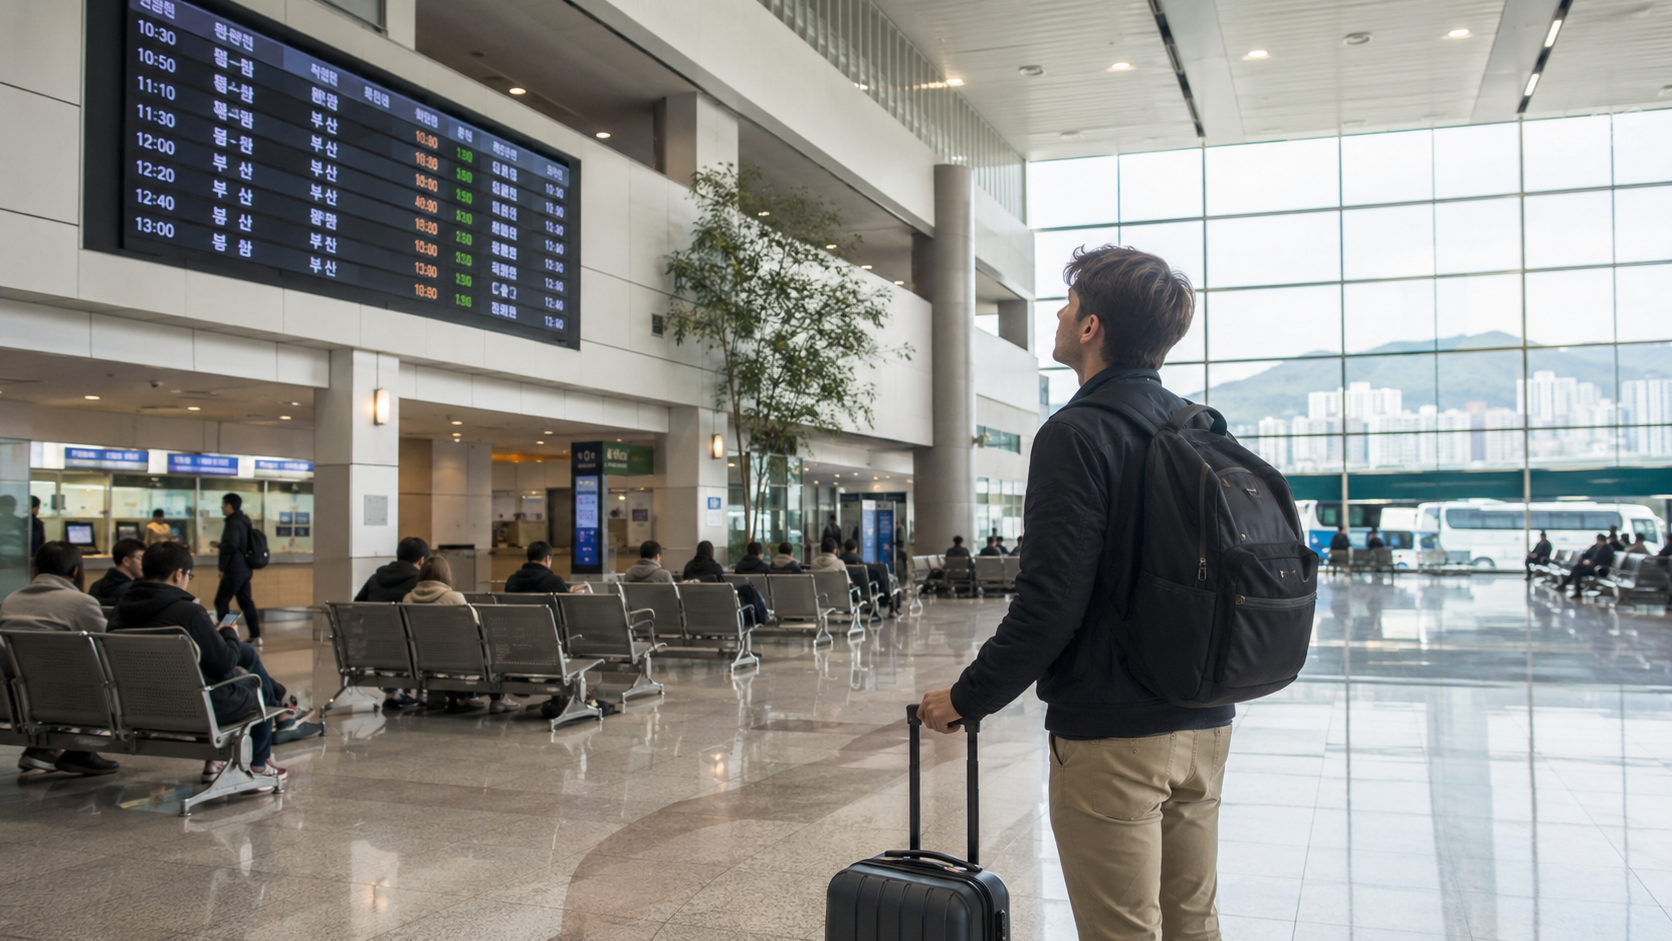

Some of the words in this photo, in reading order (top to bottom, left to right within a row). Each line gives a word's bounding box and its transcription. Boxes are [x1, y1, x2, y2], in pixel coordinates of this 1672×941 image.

[138, 19, 176, 45] 10:30
[138, 48, 176, 72] 10:50
[311, 110, 338, 134] 부산
[138, 76, 175, 100] 11:10
[311, 135, 338, 158] 부산
[137, 104, 175, 128] 11:30
[311, 160, 337, 182] 부산
[137, 132, 175, 155] 12:00
[310, 184, 337, 206] 부산
[137, 160, 175, 182] 12:20
[136, 189, 175, 210] 12:40
[136, 217, 174, 238] 13:00
[310, 257, 337, 277] 부산
